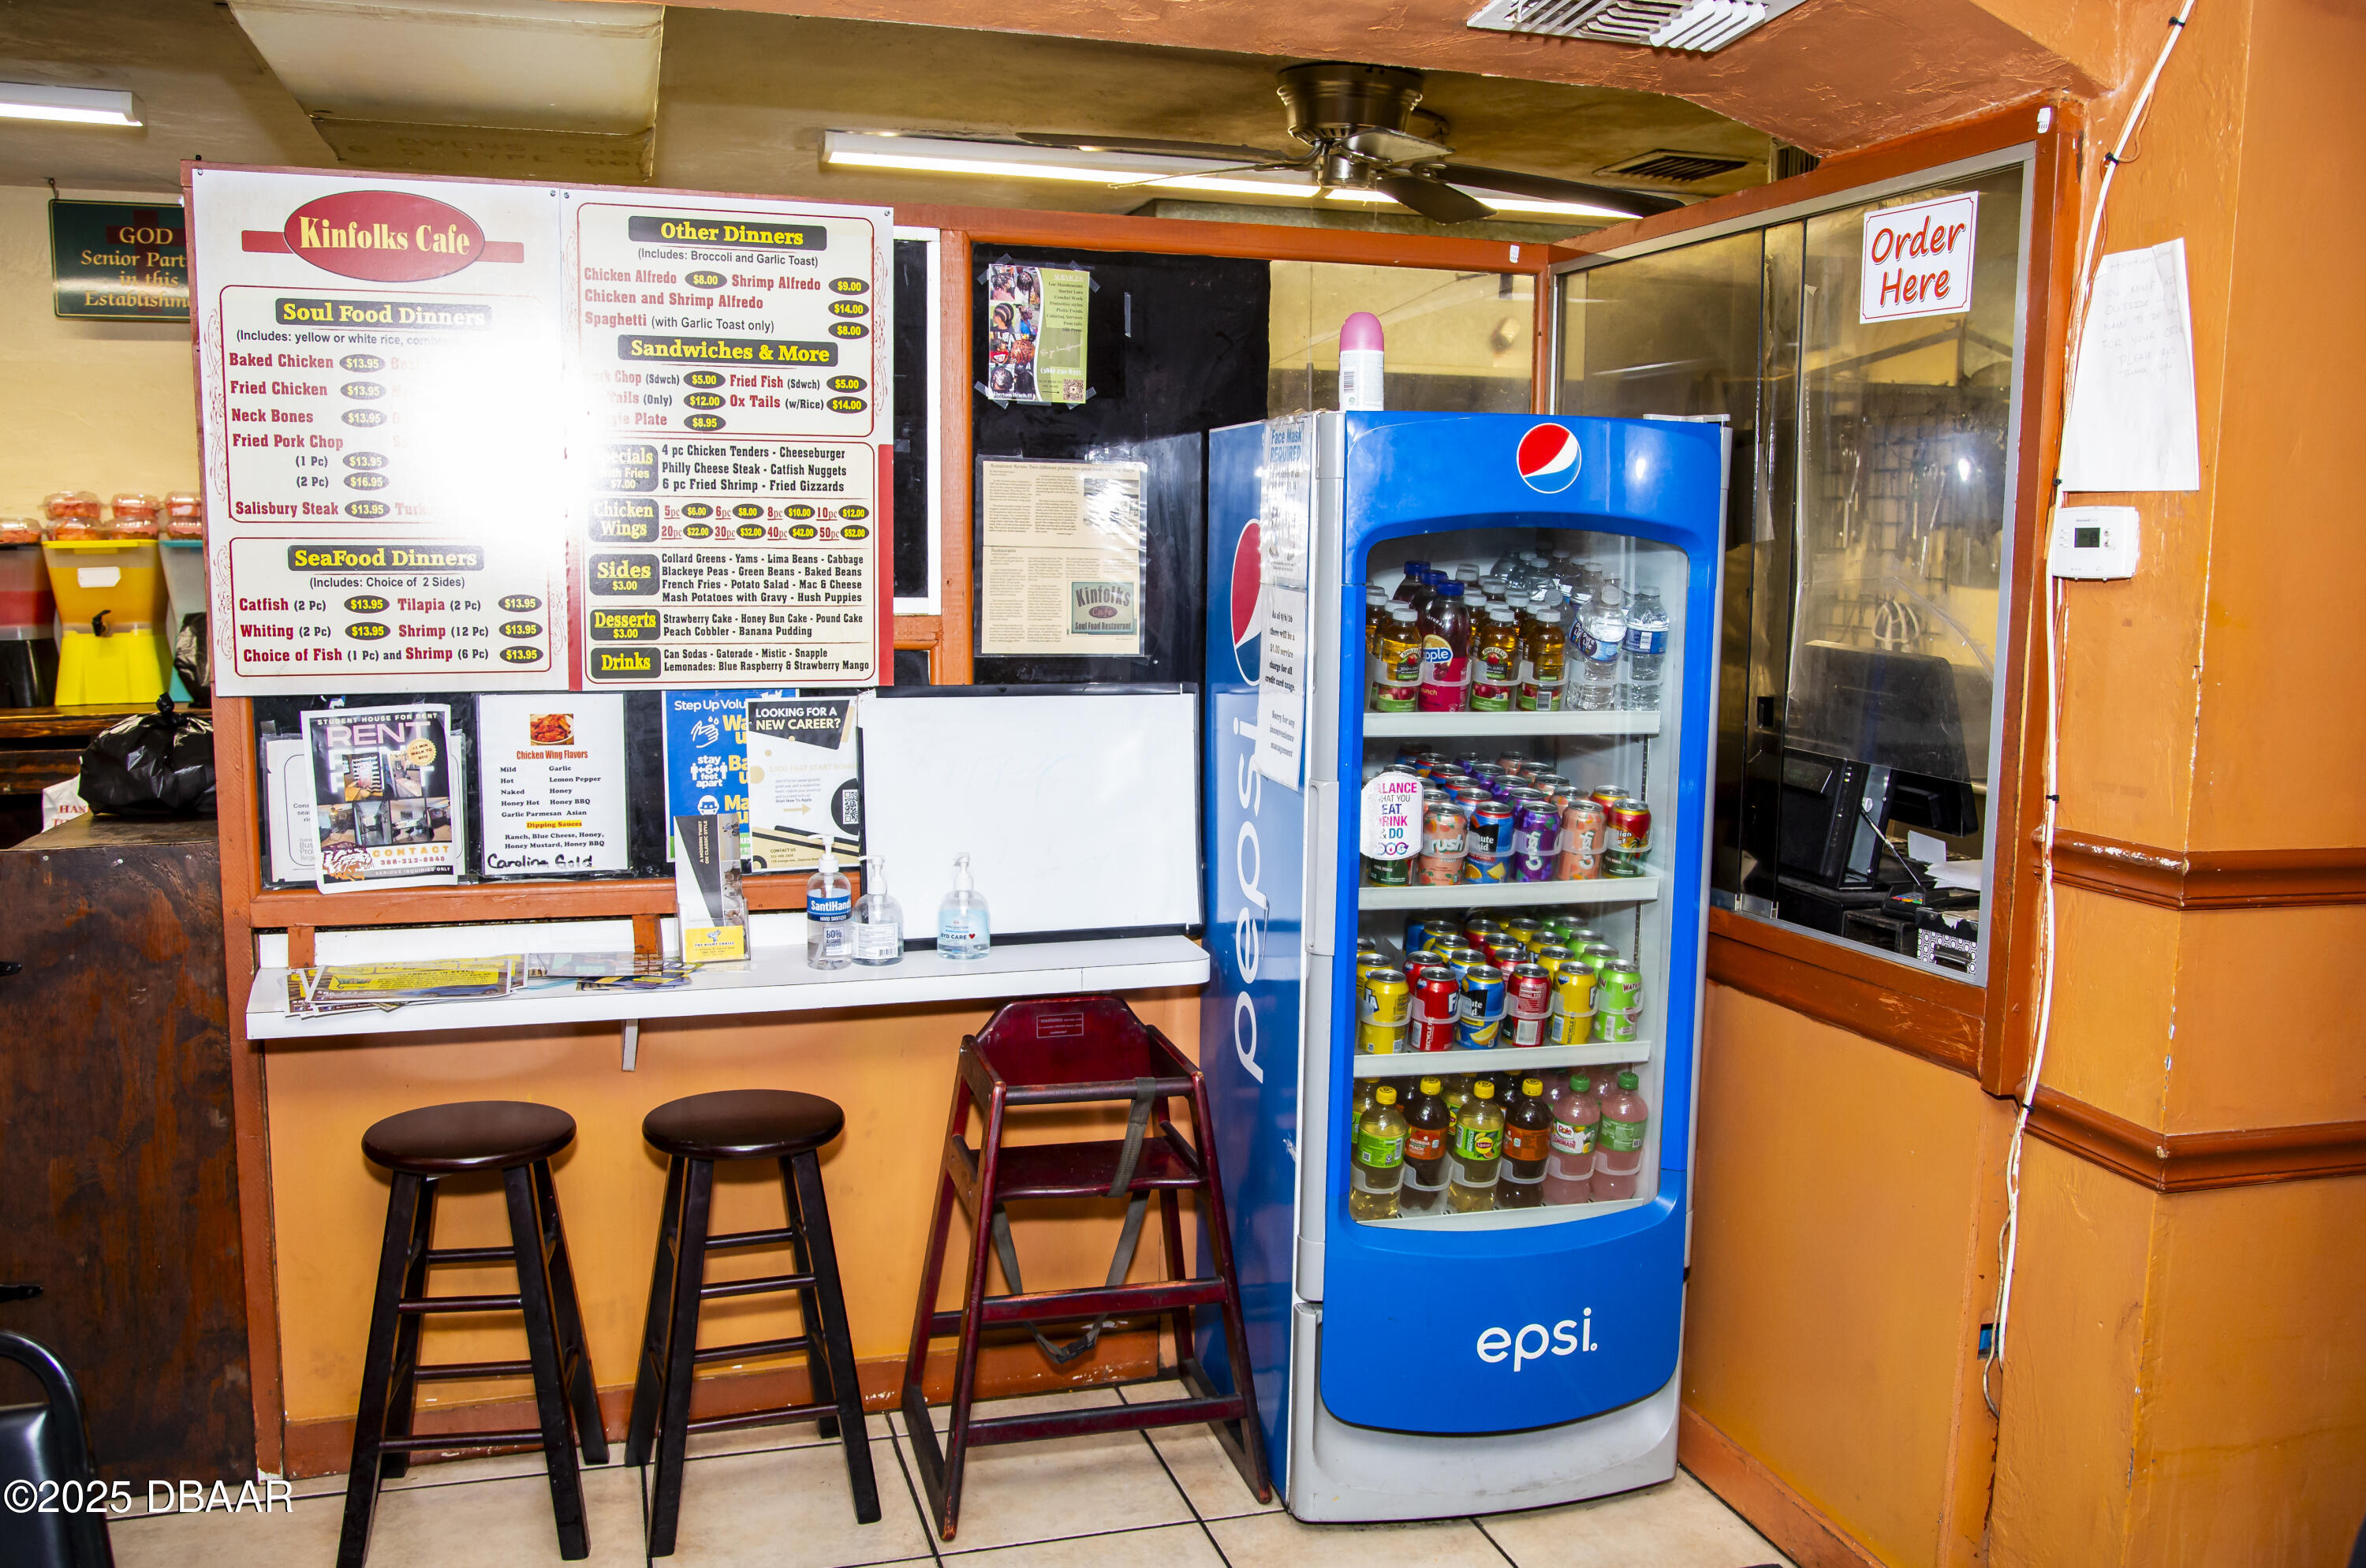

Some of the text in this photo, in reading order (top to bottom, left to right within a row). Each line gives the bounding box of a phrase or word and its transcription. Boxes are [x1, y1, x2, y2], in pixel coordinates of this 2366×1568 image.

[120, 227, 173, 245] GOD
[299, 216, 469, 255] Kinfolks Cafe
[661, 222, 803, 245] Other Dinners
[1871, 215, 1965, 265] Order
[80, 250, 140, 265] Senior
[120, 271, 178, 287] in this
[732, 275, 861, 292] Shrimp Alfredo $9.00
[1879, 267, 1950, 307] Here
[283, 303, 486, 327] Soul Food Dinners
[585, 312, 774, 333] Spaghetti (with Garlic Toast only)
[631, 340, 829, 362] Sandwiches & More
[230, 353, 272, 368] Baked
[278, 355, 334, 369] Chicken
[345, 358, 379, 369] $13.95
[730, 395, 861, 410] Ox Tails (w/Rice) $14.00
[1271, 427, 1301, 444] Face Mask
[1271, 446, 1301, 462] REQUIRED
[662, 462, 846, 478] Philly Cheese Steak Catfish Nuggets
[236, 502, 384, 517] Salisbury Steak $13.95
[664, 506, 707, 518] 5pc $6.00
[817, 508, 864, 519] 10pc $12.00
[295, 549, 477, 566] SeaFood Dinners
[597, 562, 651, 579] Sides
[310, 577, 465, 588] (Includes: Choice of 2 Sides)
[612, 581, 637, 591] $3.00
[799, 581, 862, 589] Mac & Cheese
[1076, 585, 1130, 607] Kinfolks
[239, 598, 383, 611] Catfish (2 Pc) $13.95
[1093, 607, 1113, 616] Cafe
[595, 612, 656, 627] Desserts
[663, 614, 732, 625] Strawberry Cake
[1583, 633, 1595, 645] Pure
[1583, 640, 1593, 650] Life
[243, 648, 342, 662] Choice of Fish
[602, 655, 651, 670] Drinks
[1424, 648, 1448, 662] pple
[664, 662, 783, 672] Lemonades: Blue Raspberry
[1269, 661, 1280, 672] charge
[1265, 676, 1275, 685] credit
[674, 701, 701, 711] Step
[703, 700, 718, 711] Up
[756, 708, 804, 718] LOOKING
[806, 707, 827, 716] FOR
[756, 719, 841, 730] NEW CAREER?
[327, 721, 431, 747] RENT
[517, 750, 588, 760] Chicken Wing Flavors
[698, 756, 721, 765] stay
[706, 763, 713, 774] 6
[696, 779, 722, 788] apart
[1378, 782, 1417, 793] LANCE
[1378, 816, 1407, 827] RINK
[1390, 828, 1403, 838] DO
[1431, 834, 1463, 853] rush
[1525, 831, 1542, 871] Crush
[1579, 831, 1595, 869] Crush
[373, 846, 448, 857] CONTACT
[487, 853, 592, 868] Carolina Gold
[1233, 716, 1267, 1084] pepsi
[1558, 1125, 1571, 1135] Dole
